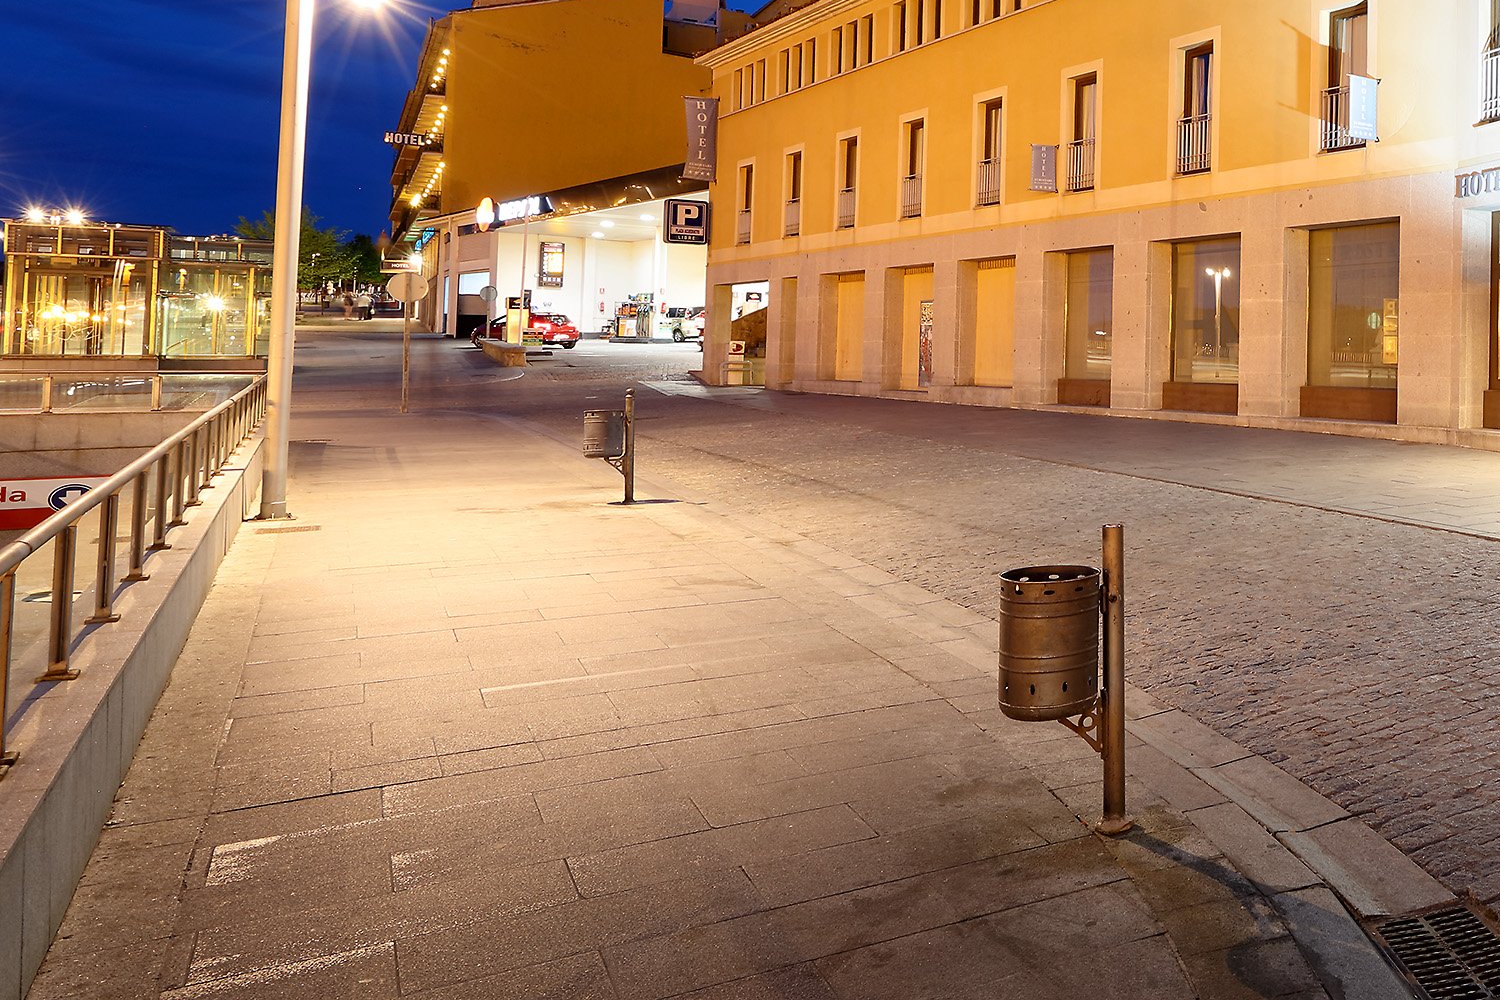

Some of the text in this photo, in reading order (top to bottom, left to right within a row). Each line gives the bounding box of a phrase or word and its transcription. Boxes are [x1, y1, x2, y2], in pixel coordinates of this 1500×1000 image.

[384, 132, 425, 146] HOTEL
[697, 101, 707, 160] HOTEL
[677, 204, 698, 225] P
